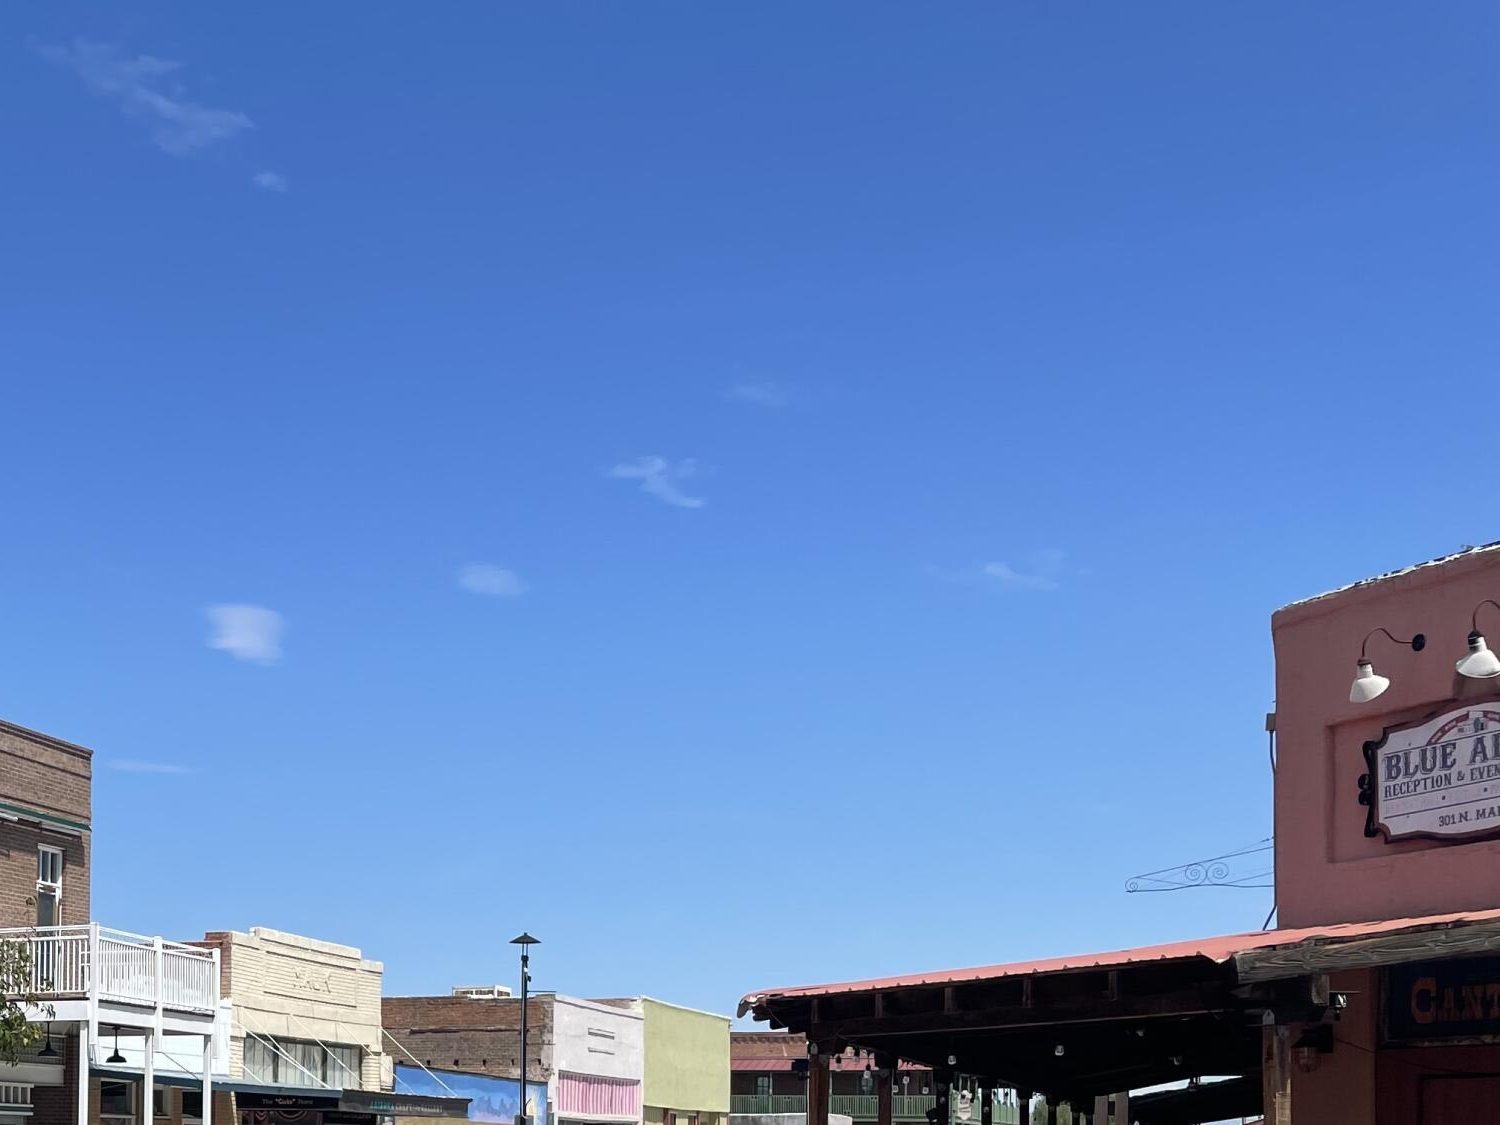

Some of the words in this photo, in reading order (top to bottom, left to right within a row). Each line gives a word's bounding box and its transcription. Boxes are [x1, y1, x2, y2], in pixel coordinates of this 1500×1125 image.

[1384, 742, 1457, 782] BLUE
[1384, 773, 1452, 799] RECEPTION
[1457, 770, 1465, 781] &
[1470, 763, 1500, 781] EVEN
[1438, 813, 1457, 827] 301
[1475, 804, 1500, 820] MAI
[1411, 976, 1500, 1024] CANT
